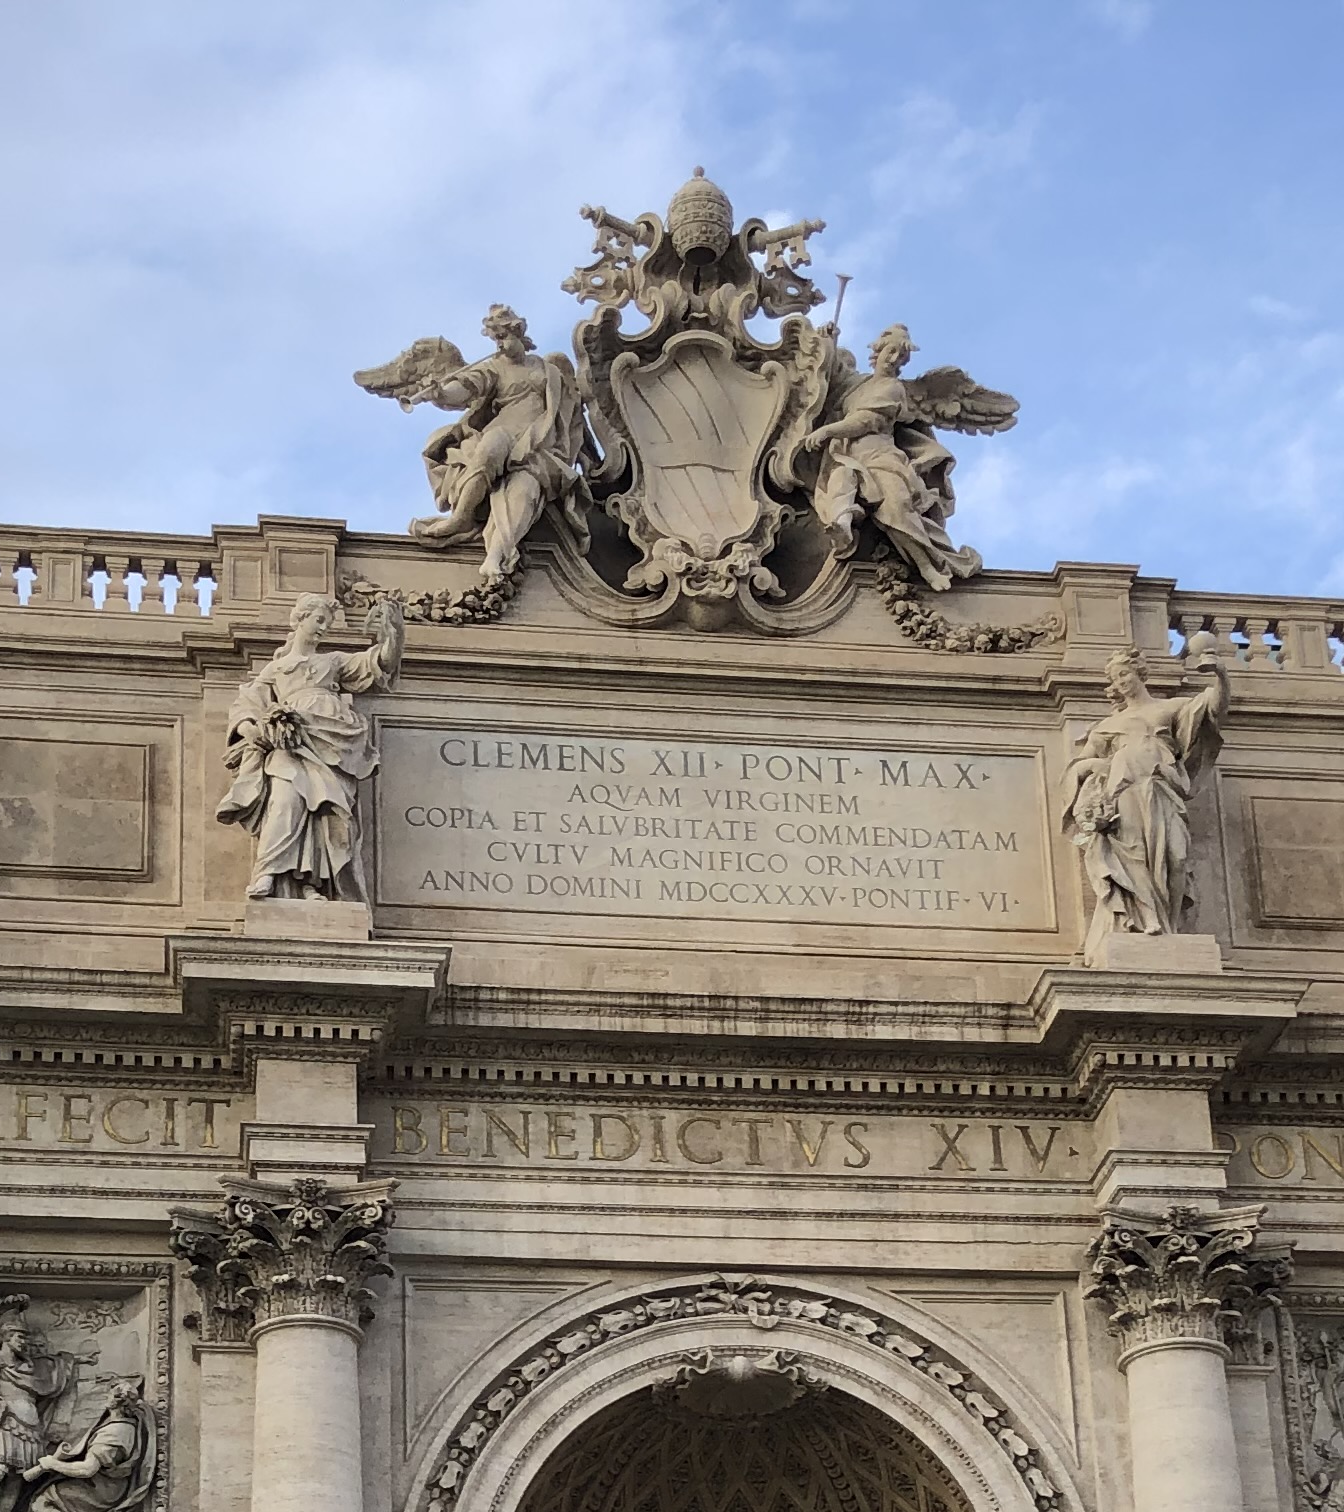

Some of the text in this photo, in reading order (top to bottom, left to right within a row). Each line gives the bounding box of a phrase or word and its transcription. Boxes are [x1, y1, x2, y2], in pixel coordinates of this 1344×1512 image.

[440, 738, 626, 774] CLEMENS
[567, 784, 861, 815] AQVAM VIRGINEM
[404, 806, 1019, 852] COPIA ET SALVBRITATE COMMENDATAM
[487, 841, 944, 880] CVLTV MAGNIFICO ORNAVIT
[418, 870, 514, 894] ANNO
[526, 874, 642, 899] DOMINI
[390, 1104, 871, 1169] BENEDICTVS
